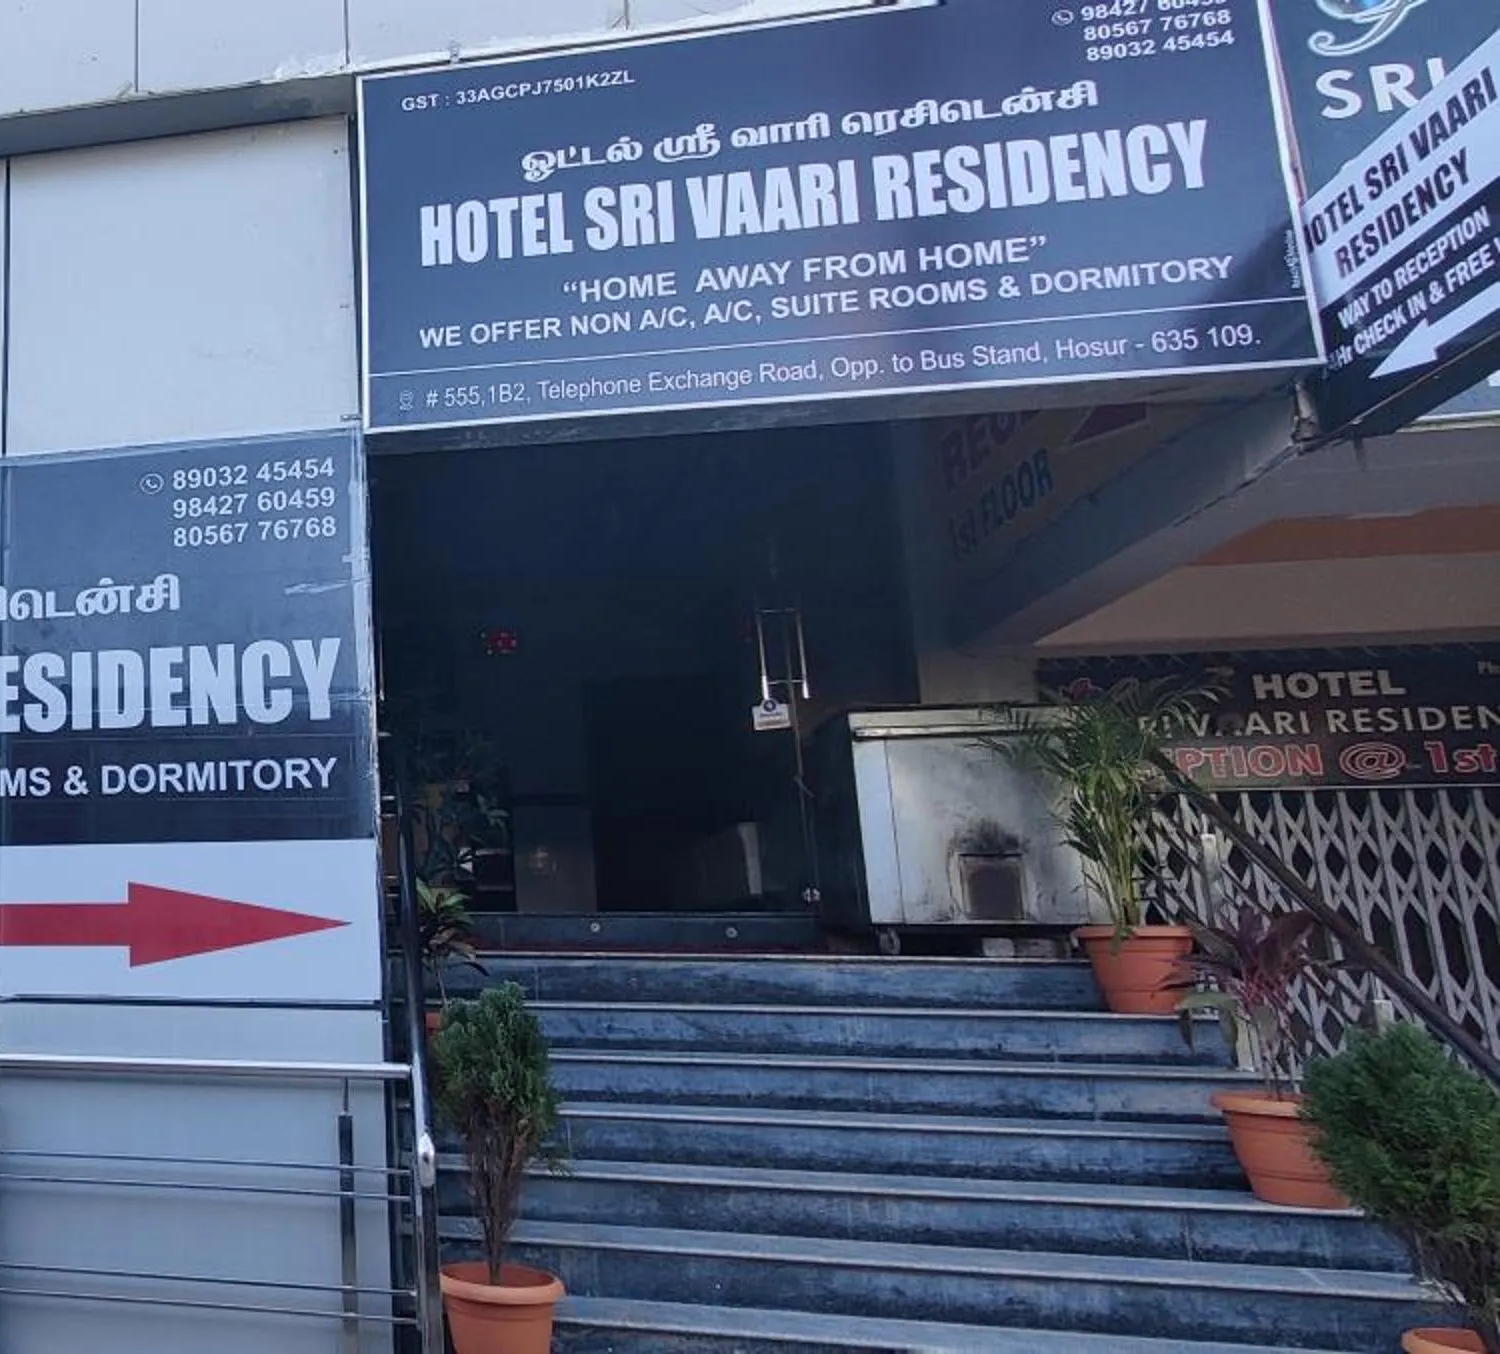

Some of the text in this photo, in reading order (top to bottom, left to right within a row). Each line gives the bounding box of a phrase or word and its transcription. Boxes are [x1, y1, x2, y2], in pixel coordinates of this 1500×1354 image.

[1084, 9, 1232, 41] 80567 76768
[1086, 29, 1235, 62] 89032 45454
[402, 70, 636, 111] GST 33AGCPJ7501K2ZL
[1315, 57, 1445, 119] SRI
[521, 136, 643, 183] ஓட்டல்
[730, 113, 830, 150] வாரி
[841, 79, 1099, 137] ரெசிடென்சி
[1364, 66, 1498, 201] SRI VAARI
[420, 119, 1208, 267] HOTEL SRI VAARI RESIDENCY
[1334, 147, 1469, 279] RESIDENCY
[695, 260, 792, 293] AWAY
[803, 249, 907, 284] FROM
[1337, 291, 1370, 330] WAY
[1372, 278, 1393, 305] TO
[1393, 206, 1491, 290] RECEPTION
[419, 255, 1234, 349] WE OFFER NON A/C, A/C, SUITE ROOMS & DORMITORY
[1353, 306, 1408, 354] CHECK
[1407, 291, 1428, 319] IN
[1429, 280, 1446, 304] &
[1445, 244, 1495, 292] FREE
[538, 376, 641, 403] Telephone
[648, 367, 753, 396] Exchange
[759, 361, 822, 386] Road,
[831, 356, 885, 381] Opp.
[892, 353, 913, 373] to
[920, 349, 965, 372] Bus
[972, 341, 1048, 368] Stand,
[1056, 336, 1128, 361] Hosur
[1151, 329, 1198, 353] 635
[1206, 323, 1261, 348] 109.
[173, 457, 335, 490] 89032 45454
[980, 447, 1053, 537] FLOOR
[173, 486, 335, 519] 98427 60459
[173, 516, 336, 547] 80567 76768
[1252, 670, 1406, 699] HOTEL
[63, 765, 89, 797] &
[102, 757, 337, 795] DORMITORY
[1339, 741, 1498, 779] @ 1st
